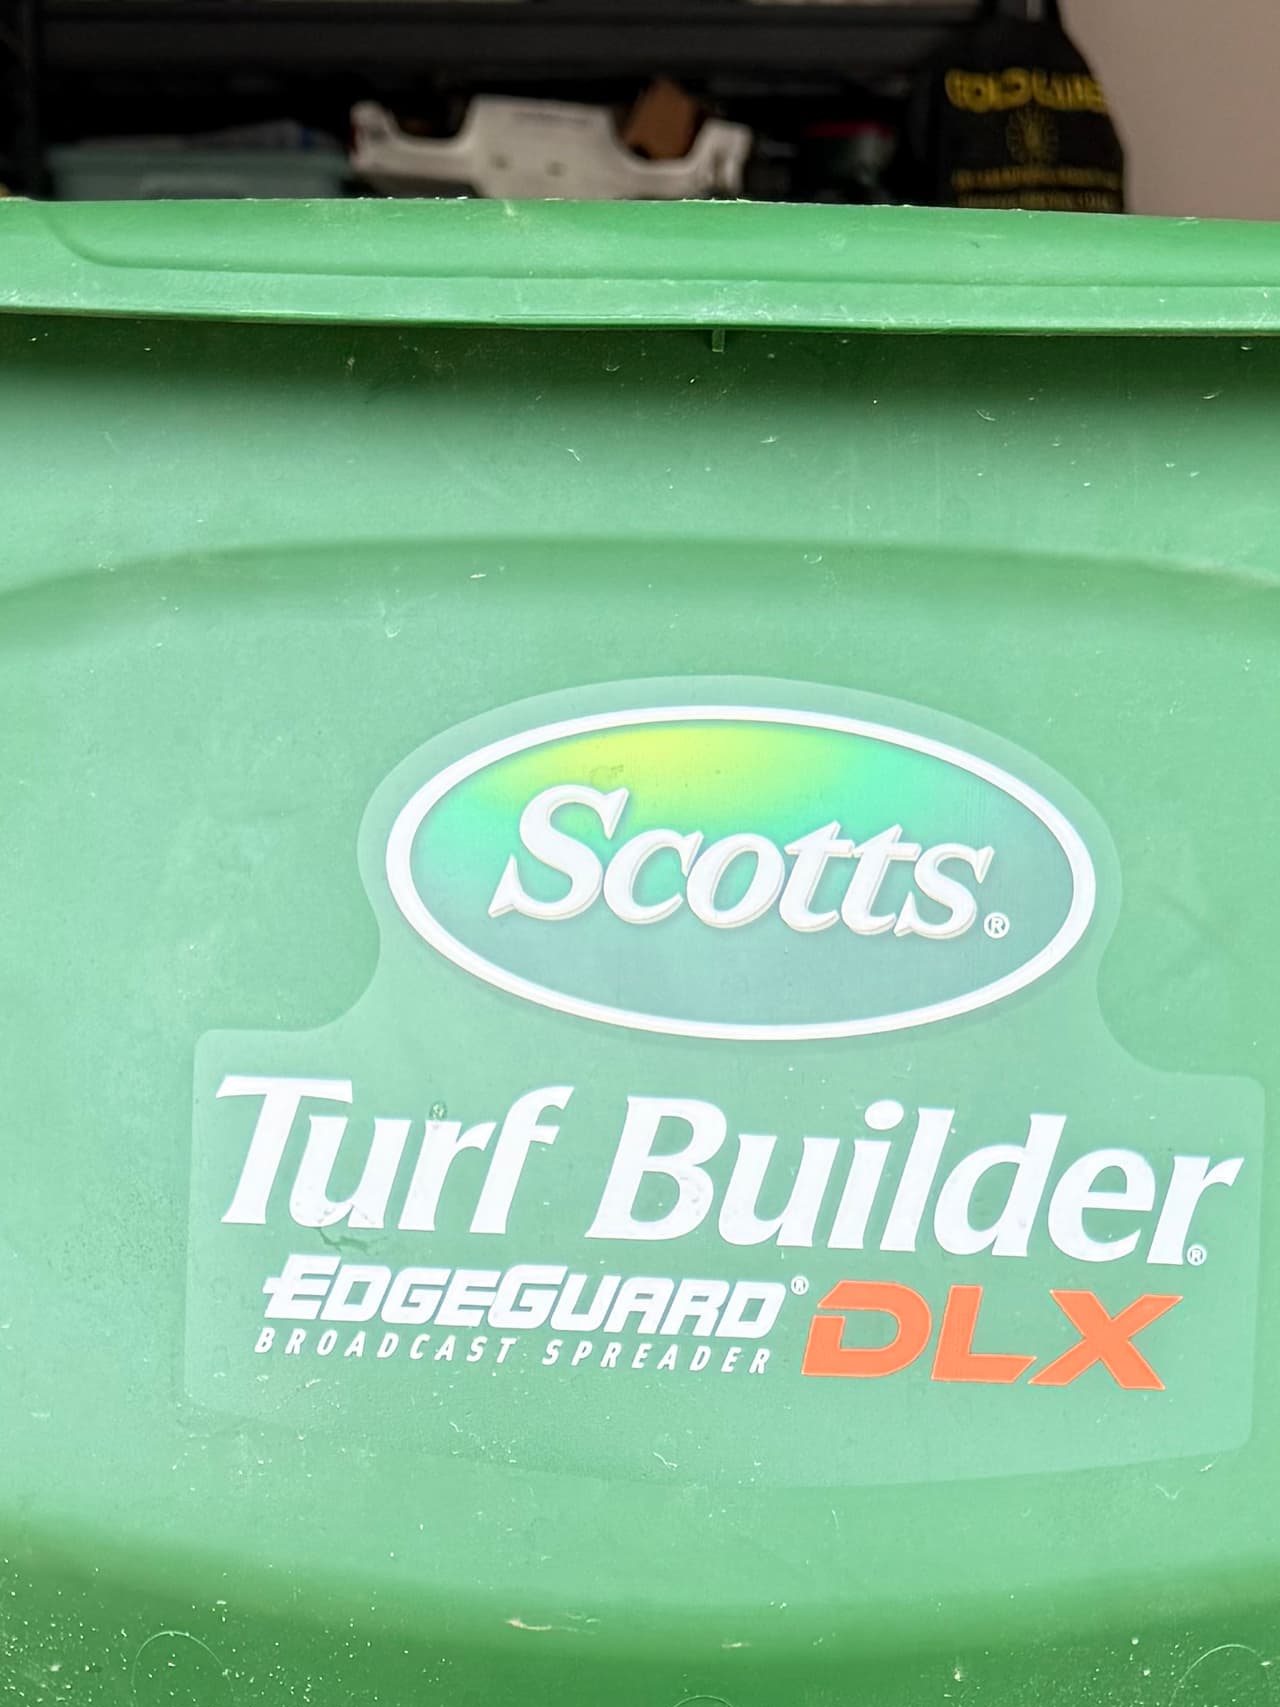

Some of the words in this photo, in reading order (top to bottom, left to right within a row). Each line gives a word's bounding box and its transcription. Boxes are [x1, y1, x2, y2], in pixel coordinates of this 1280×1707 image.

[215, 1074, 575, 1234] Turf
[254, 1327, 518, 1363] BROADCAST
[542, 1339, 770, 1374] SPREADER
[801, 1279, 1183, 1391] DLX
